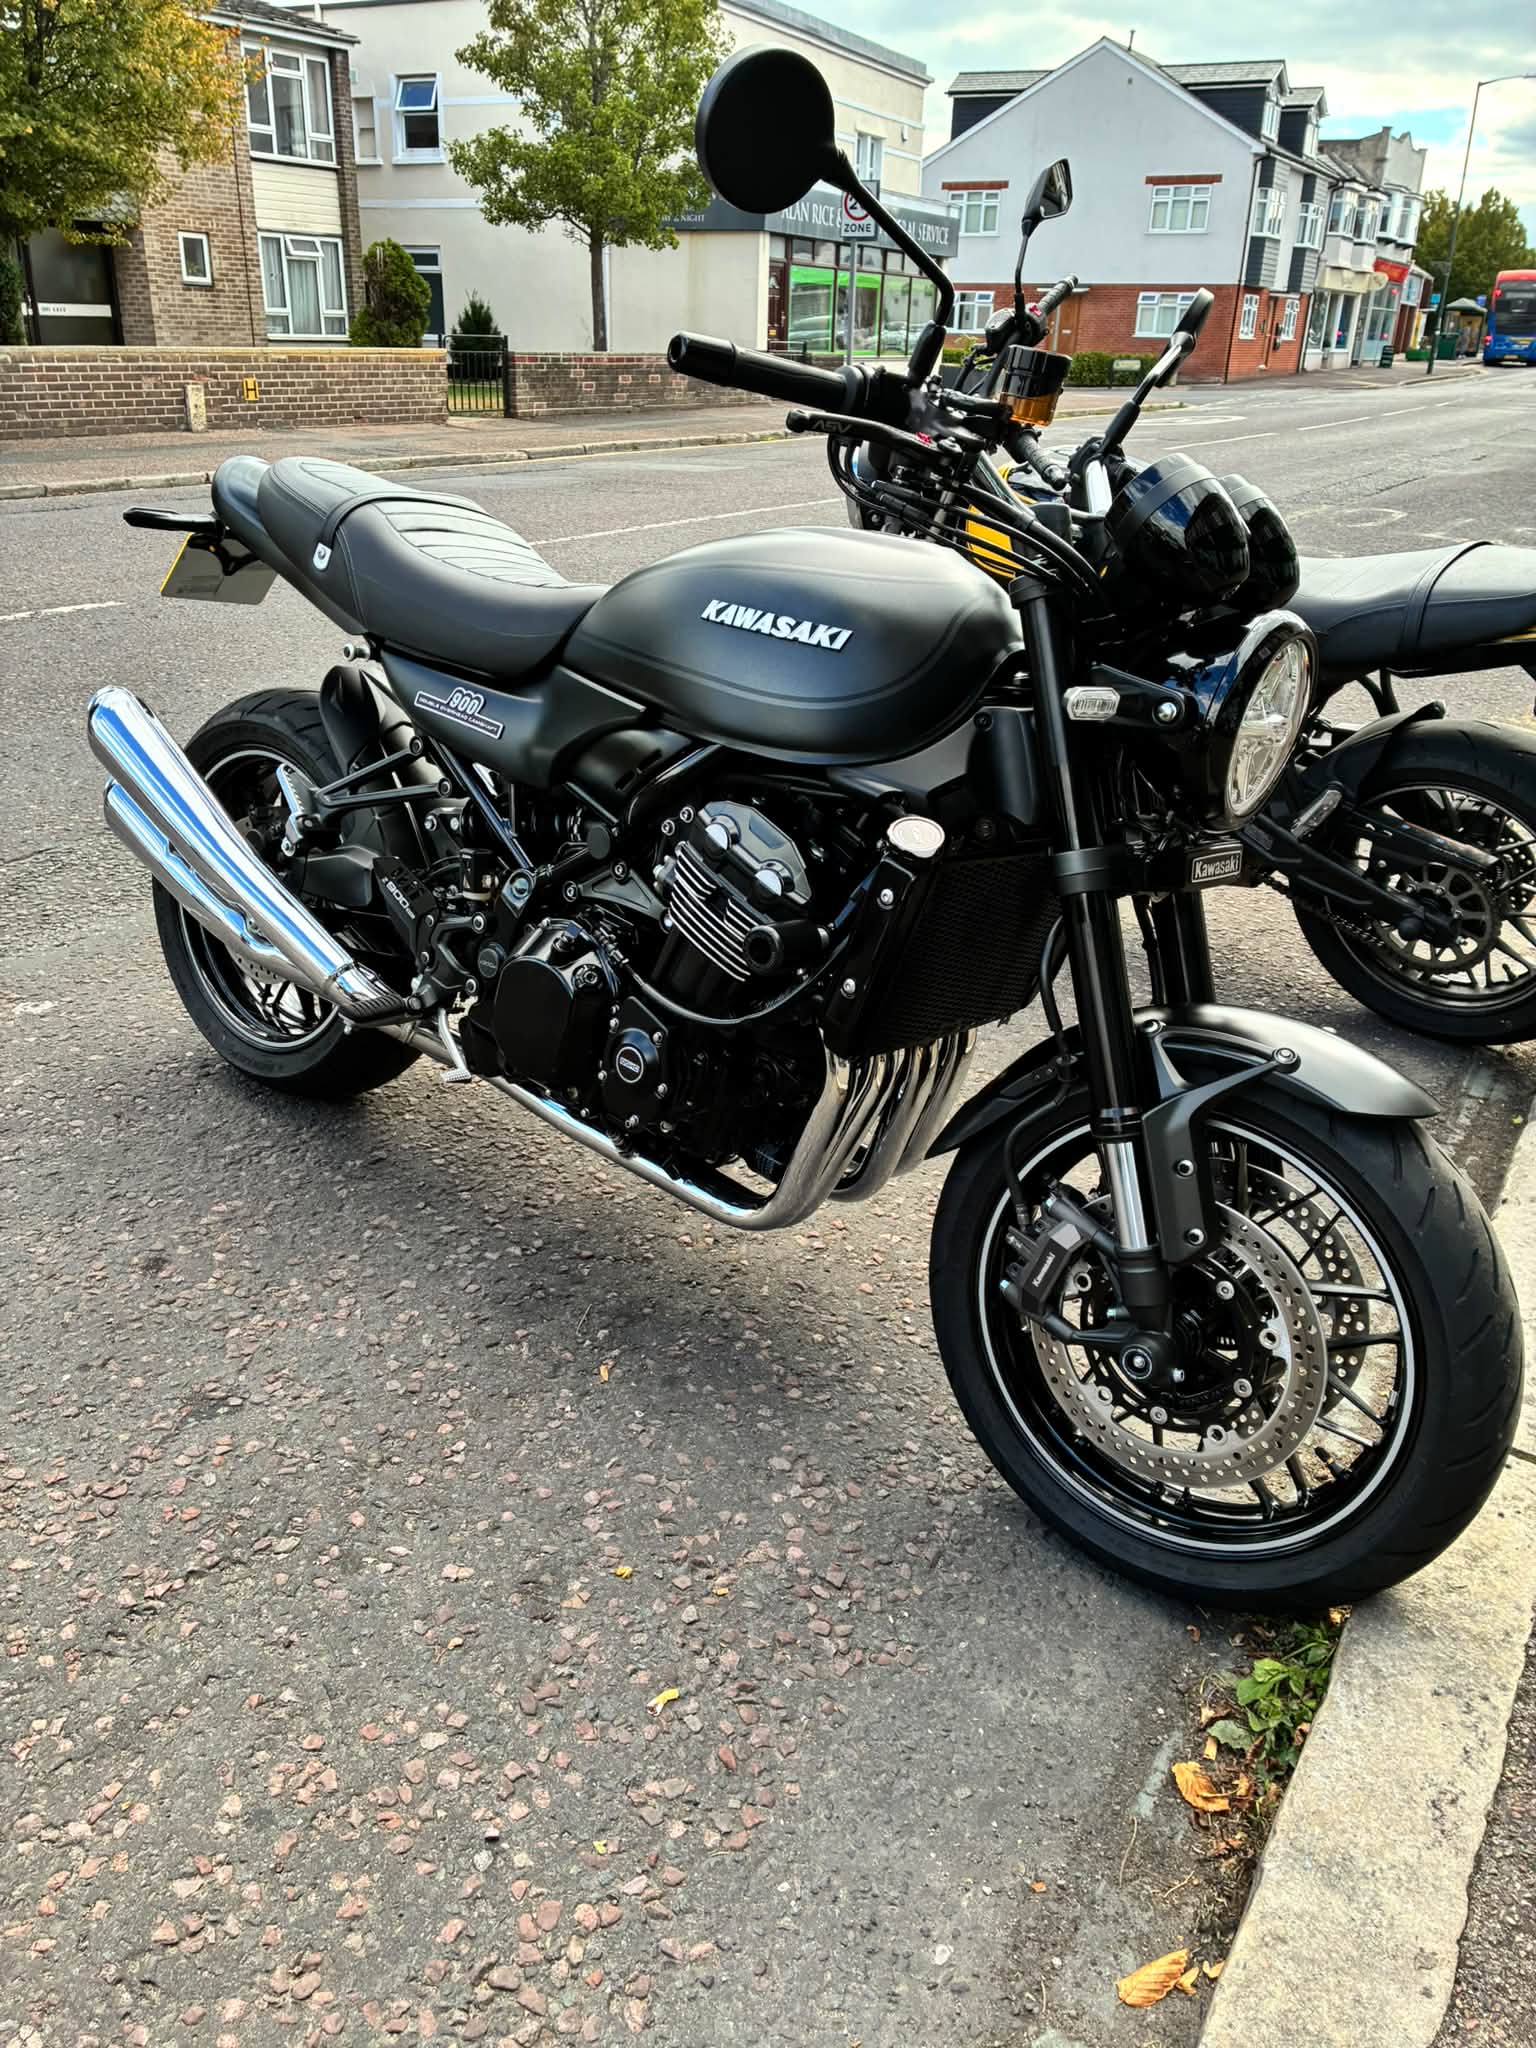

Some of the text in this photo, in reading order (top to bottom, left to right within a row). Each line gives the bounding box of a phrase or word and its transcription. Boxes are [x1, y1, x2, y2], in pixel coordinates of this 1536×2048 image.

[812, 203, 835, 226] RICE
[918, 223, 950, 245] SERVICE
[844, 223, 872, 233] ZONE
[245, 380, 258, 399] H
[701, 599, 853, 651] KAWASAKI
[449, 692, 480, 716] 900
[1195, 854, 1240, 879] Kawasaki
